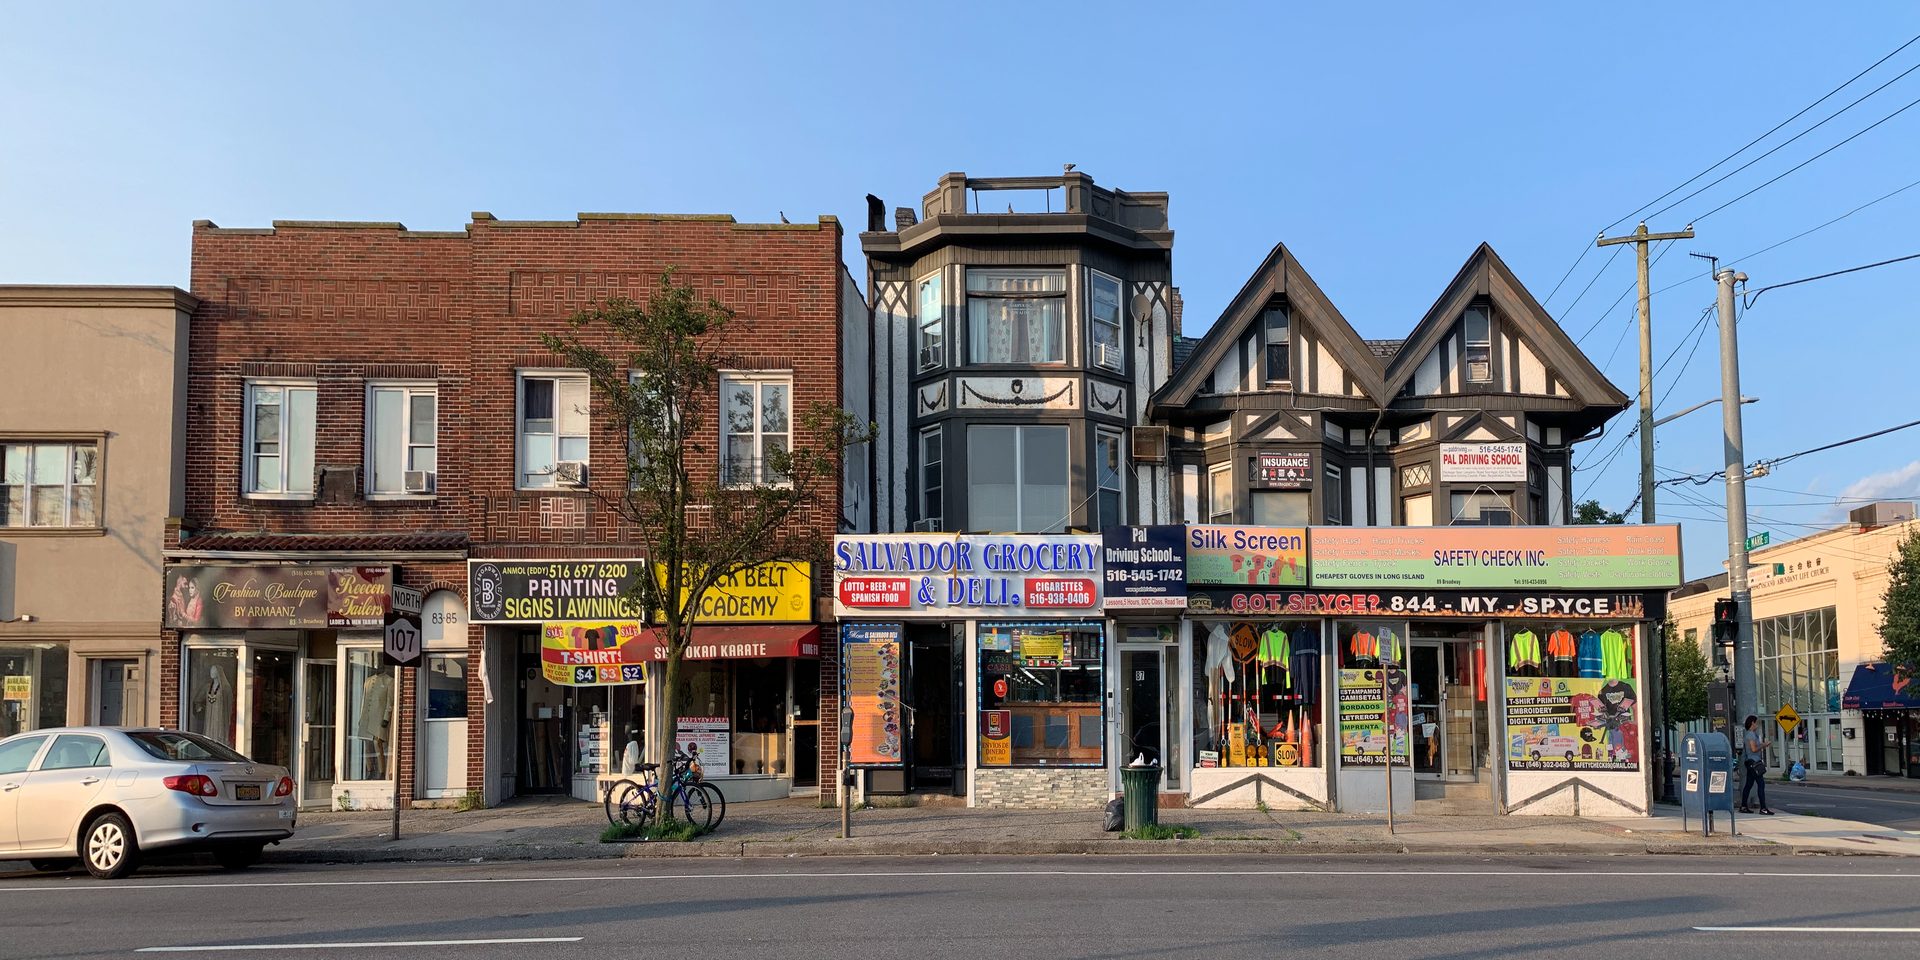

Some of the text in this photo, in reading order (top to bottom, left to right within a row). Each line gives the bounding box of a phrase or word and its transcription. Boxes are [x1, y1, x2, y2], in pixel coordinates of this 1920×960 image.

[1262, 458, 1308, 467] INSURANCE
[1443, 454, 1521, 464] PAL DRIVING SCHOOL
[1132, 527, 1147, 542] Pal
[1191, 528, 1301, 550] Silk Screen
[836, 540, 1099, 572] SALVADOR GROCERY
[1106, 547, 1139, 564] Driving
[1140, 547, 1172, 562] School
[1433, 550, 1549, 567] SAFETY CHECK INC.
[502, 564, 627, 578] ANMOL (EDDY) 516 697 6200
[745, 567, 788, 587] BELT
[1106, 569, 1183, 581] 516-545-1742
[212, 578, 318, 608] Fashion Boutique
[528, 579, 617, 597] PRINTING
[844, 581, 906, 592] LOTTO BEER ATM
[917, 576, 937, 605] &
[1036, 582, 1084, 592] CIGARETTES
[394, 590, 420, 609] NORTH
[851, 592, 899, 603] SPANISH FOOD
[1029, 592, 1090, 604] 516-938-0406
[1231, 593, 1281, 612] GOT
[1288, 594, 1379, 612] SPYCE?
[1391, 595, 1437, 611] 844
[1460, 597, 1498, 613] MY
[1523, 597, 1609, 614] SPYCE
[235, 606, 296, 617] BY ARMAANZ
[339, 595, 383, 616] Tailors
[505, 597, 554, 618] SIGNS
[696, 596, 778, 617] CADEMY
[432, 612, 458, 624] 83-85
[391, 628, 415, 652] 107
[1235, 634, 1253, 649] SLOW
[721, 643, 766, 657] KARATE
[1508, 696, 1569, 705] T-SHIRT PRINTING
[1277, 750, 1297, 760] SLOW
